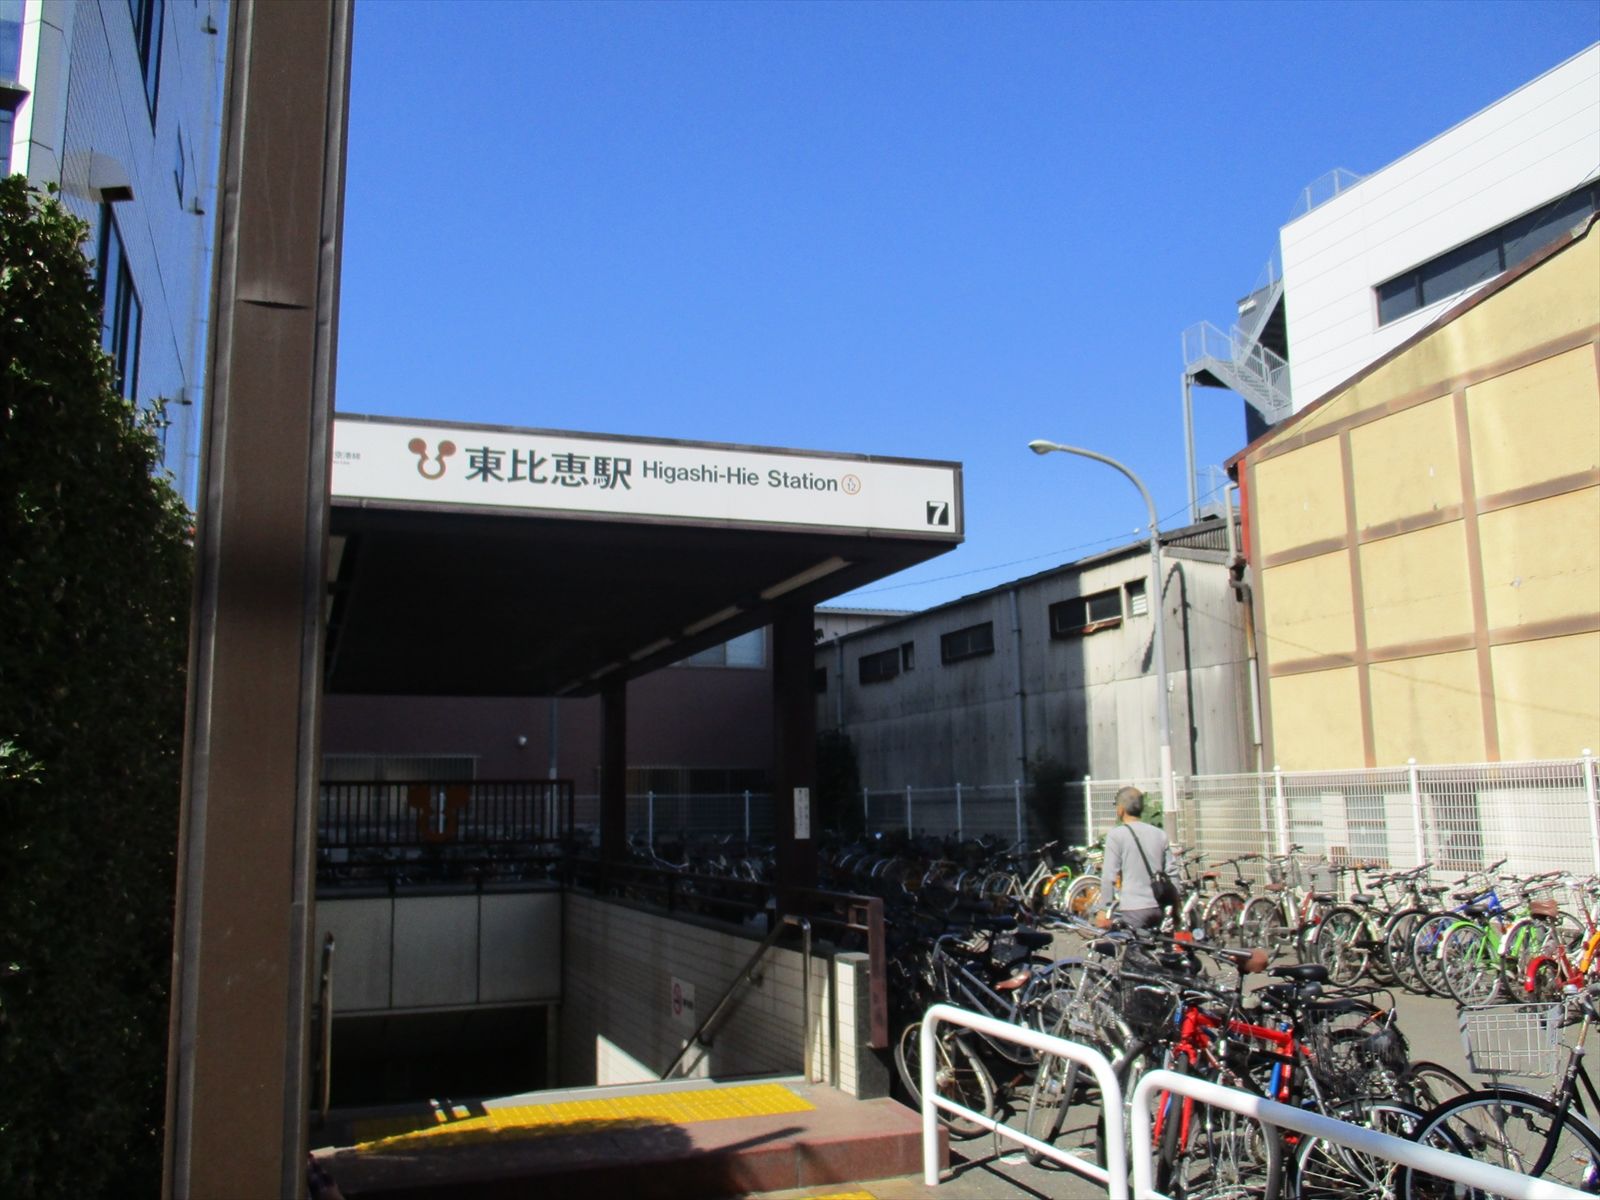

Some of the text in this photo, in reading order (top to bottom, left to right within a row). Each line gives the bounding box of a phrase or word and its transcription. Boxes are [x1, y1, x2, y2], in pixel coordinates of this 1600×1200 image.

[465, 445, 632, 489] 東比恵駅
[643, 461, 838, 492] Higashi-Hie Station
[929, 501, 946, 525] 7
